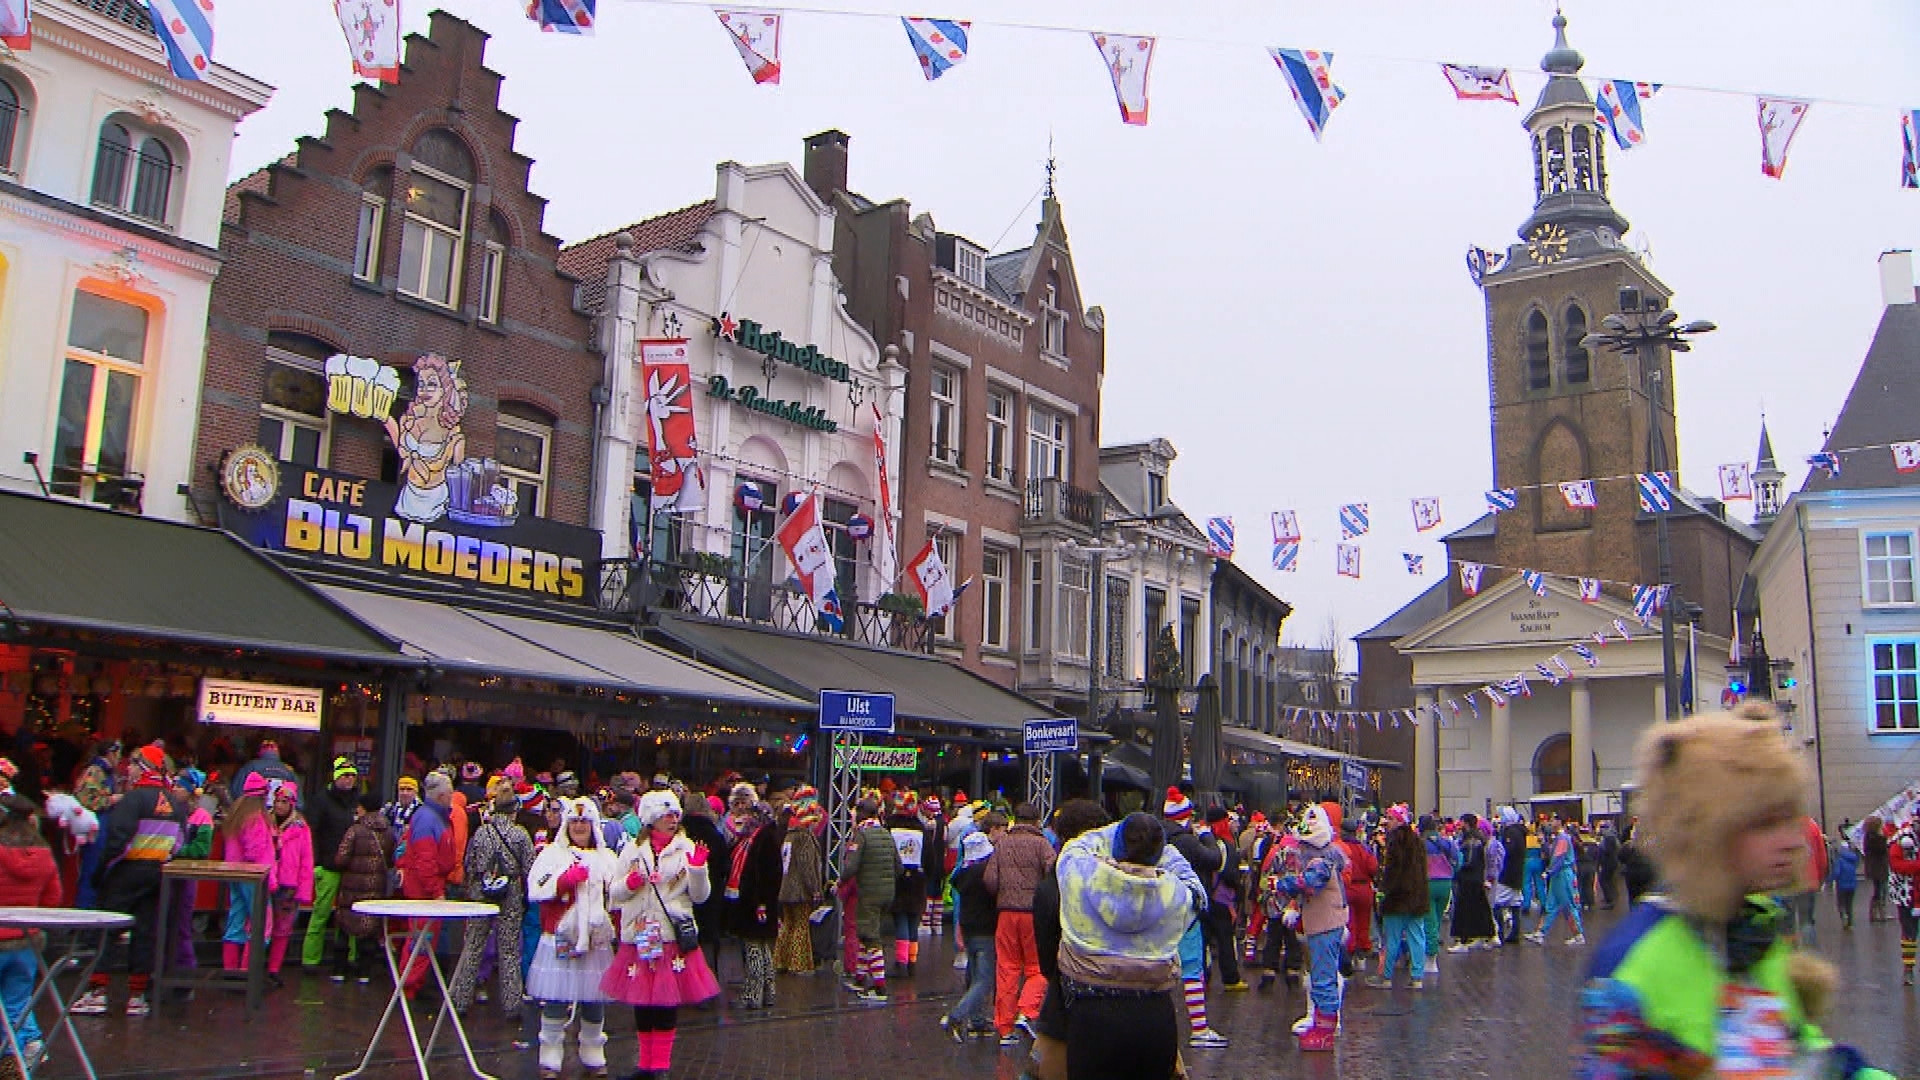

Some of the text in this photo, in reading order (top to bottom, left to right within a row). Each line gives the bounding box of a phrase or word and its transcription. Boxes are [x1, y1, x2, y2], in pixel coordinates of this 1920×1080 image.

[738, 318, 850, 383] Heineken
[303, 471, 366, 507] CAFÉ
[285, 497, 584, 598] BIJ MOEDERS
[208, 691, 317, 714] BUITEN BAR
[1026, 724, 1075, 741] Bonkevaart
